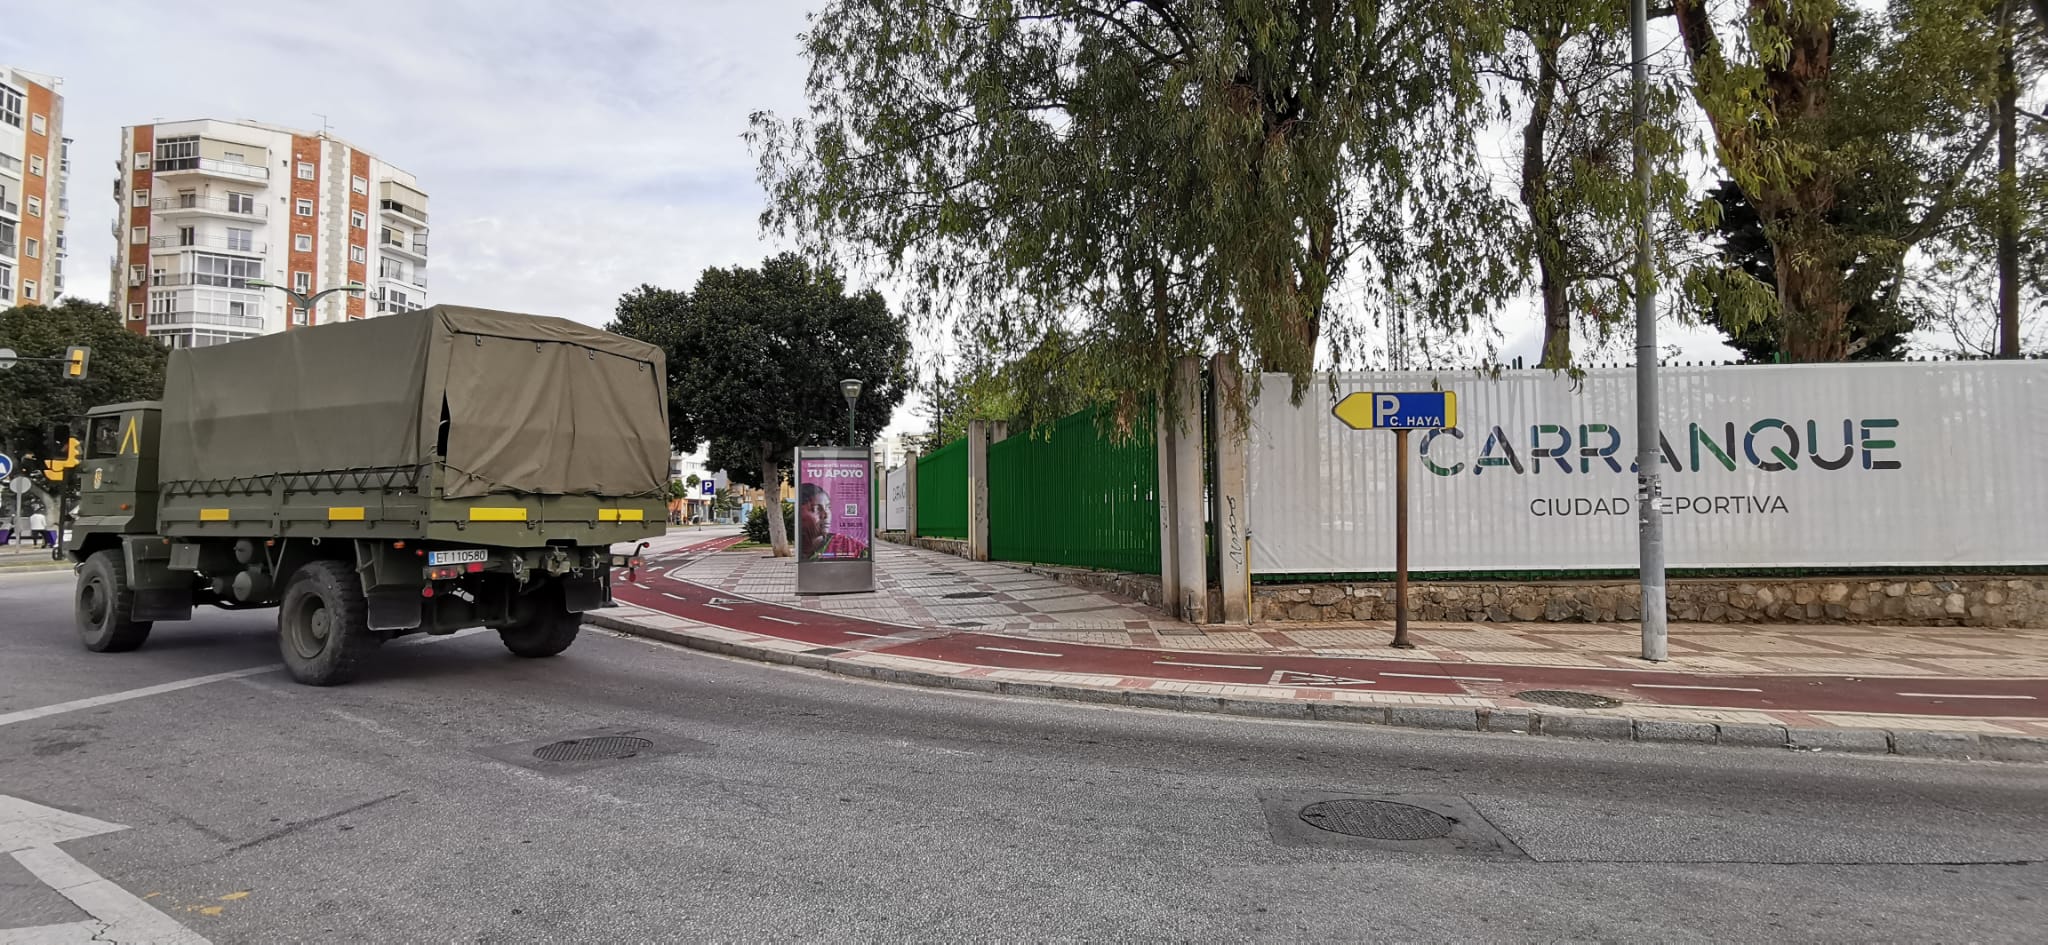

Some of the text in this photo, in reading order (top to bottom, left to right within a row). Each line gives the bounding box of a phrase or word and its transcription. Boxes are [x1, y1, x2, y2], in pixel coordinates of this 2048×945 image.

[1376, 394, 1400, 426] P
[1389, 416, 1441, 426] C. HAYA
[807, 469, 864, 478] TU APOYO
[704, 481, 713, 491] P
[1529, 495, 1789, 518] CIUDAD EPORTIVA
[436, 550, 486, 563] ET 110580
